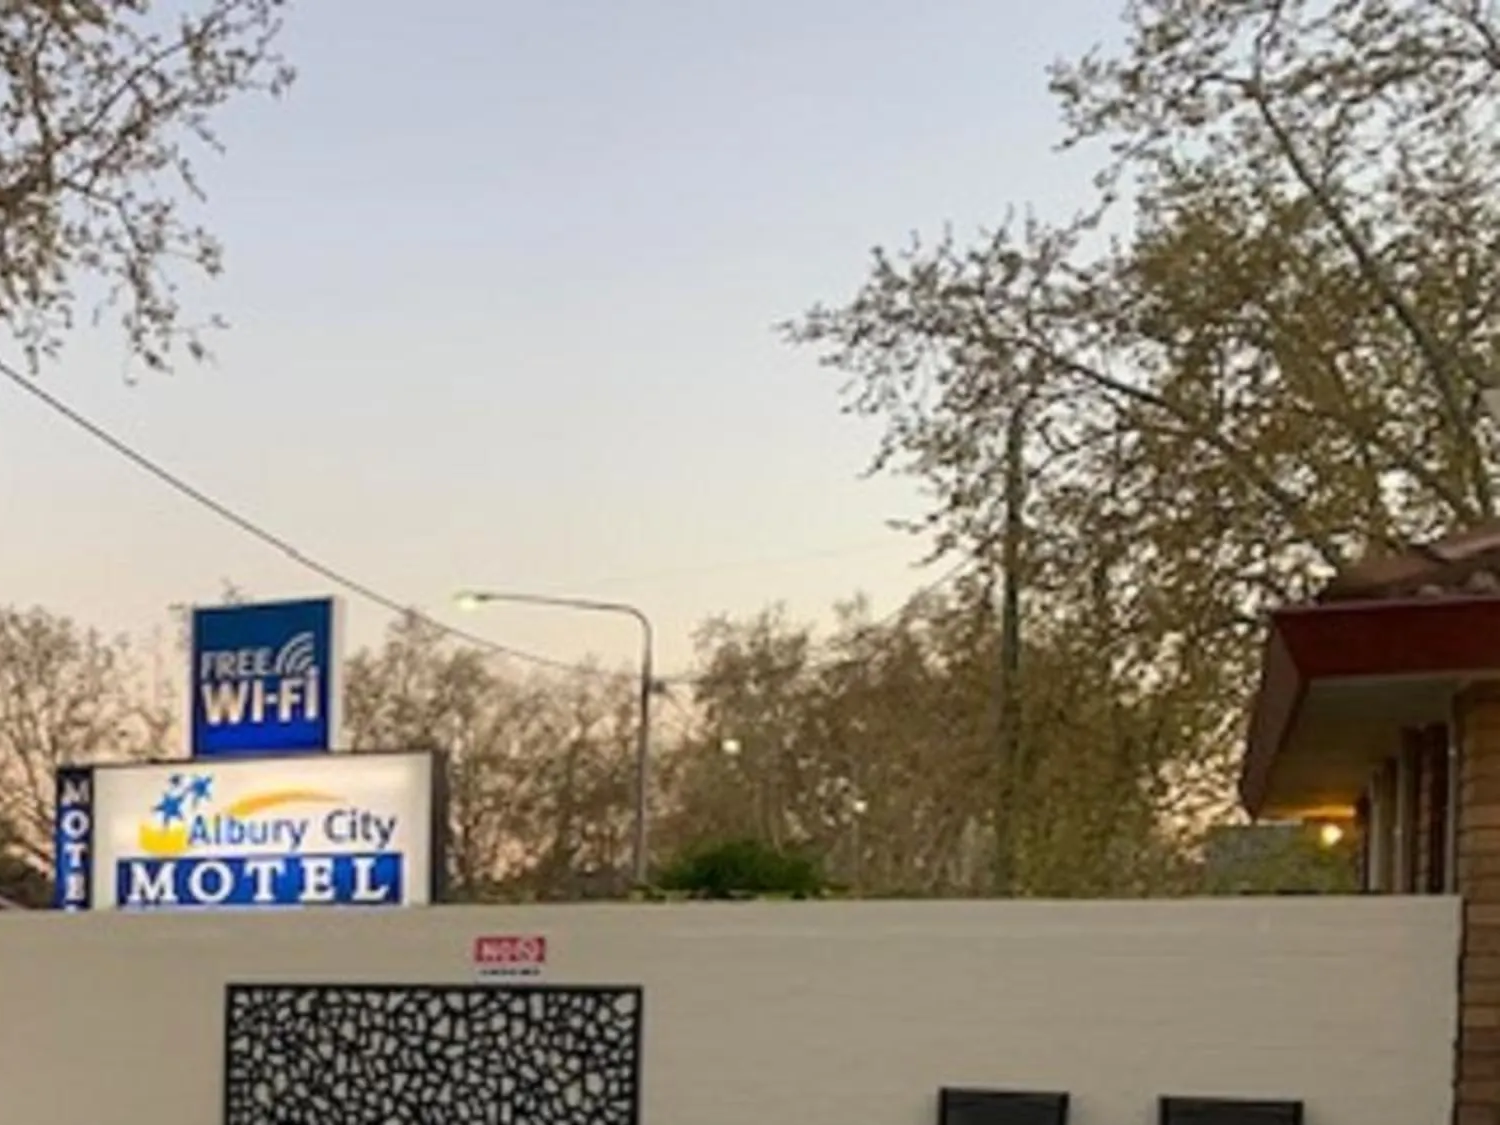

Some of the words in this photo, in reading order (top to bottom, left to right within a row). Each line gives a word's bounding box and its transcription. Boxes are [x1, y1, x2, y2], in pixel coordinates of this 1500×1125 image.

[201, 646, 274, 680] FREE
[187, 814, 309, 850] Albury
[323, 809, 397, 849] City
[127, 856, 390, 904] MOTEL
